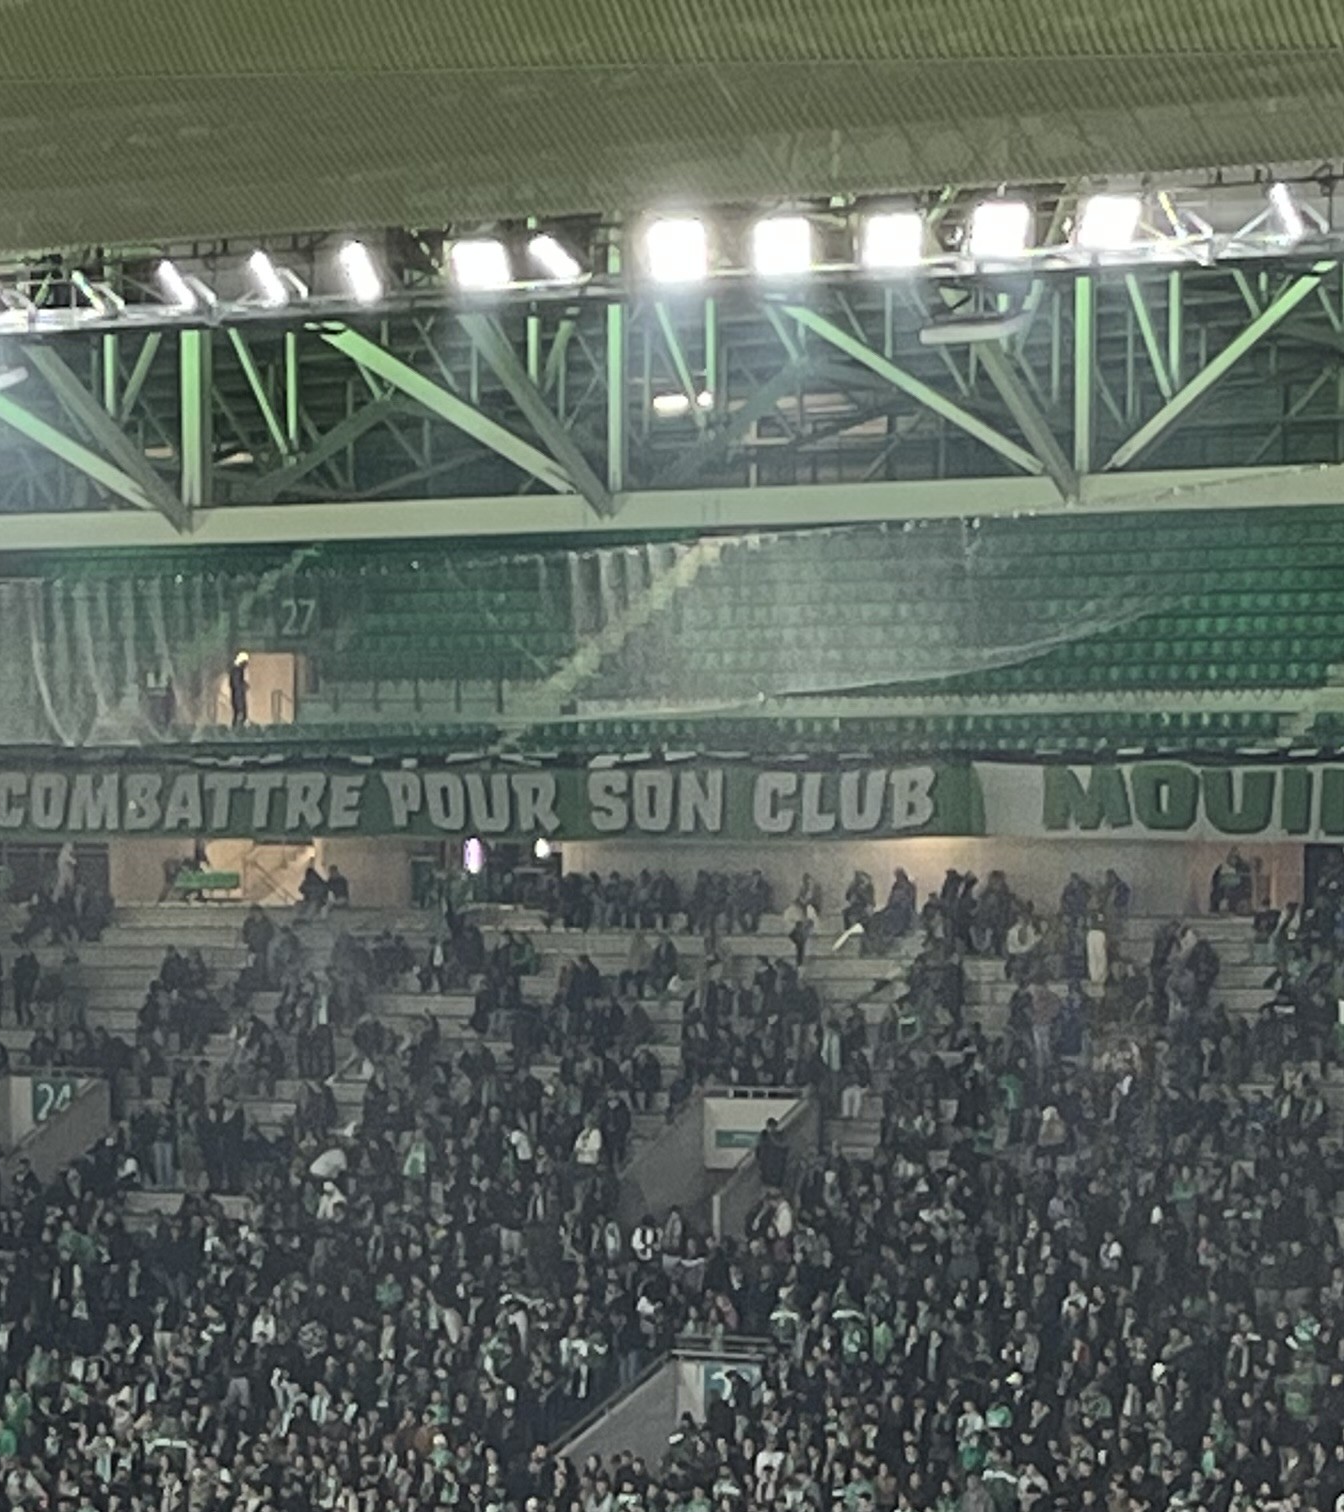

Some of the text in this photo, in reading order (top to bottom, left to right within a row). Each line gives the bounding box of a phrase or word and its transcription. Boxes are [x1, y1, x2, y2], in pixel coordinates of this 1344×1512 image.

[281, 599, 316, 635] 27
[381, 771, 559, 831] POUR
[587, 769, 726, 831] SON
[756, 765, 936, 832] CLUB
